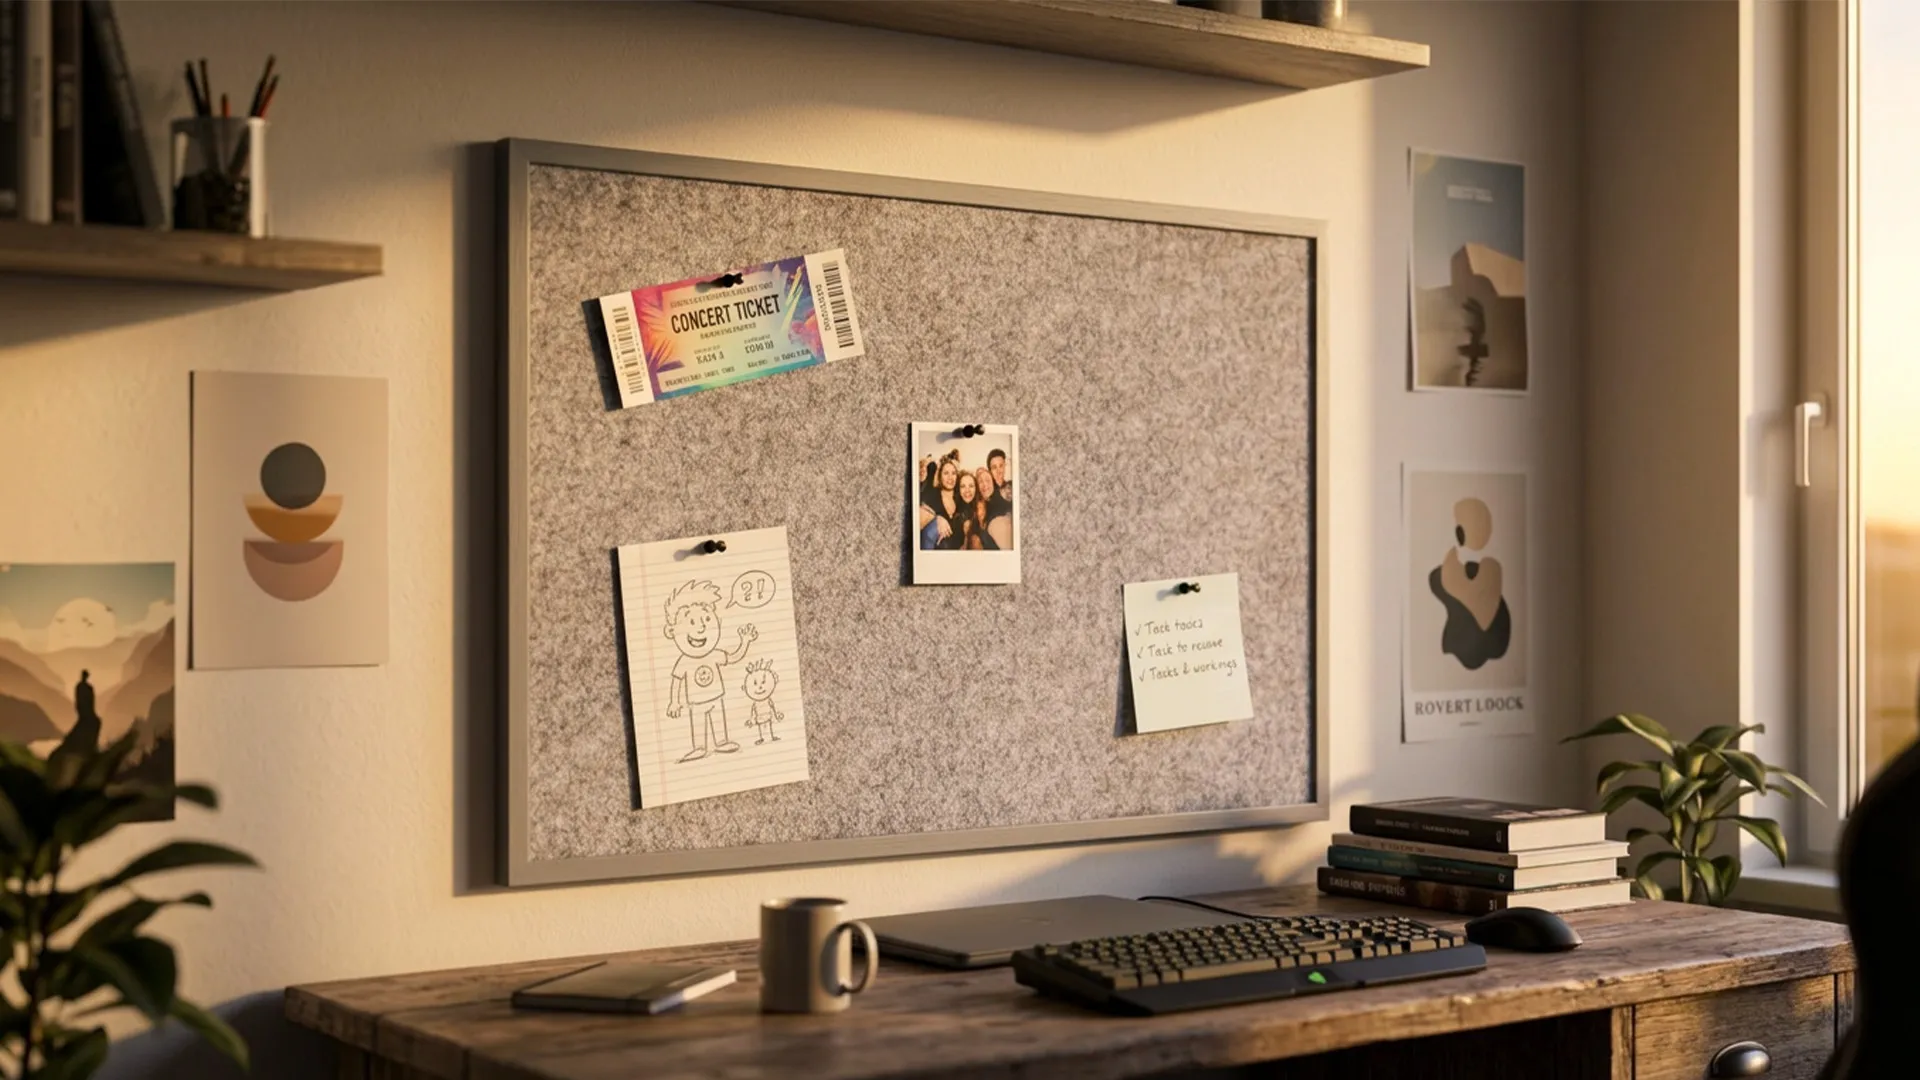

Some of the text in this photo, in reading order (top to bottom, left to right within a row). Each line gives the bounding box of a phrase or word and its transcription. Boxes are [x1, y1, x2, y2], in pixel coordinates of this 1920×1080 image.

[671, 304, 731, 334] CONCERT
[735, 294, 781, 321] TICKET
[1415, 698, 1472, 715] ROVERT
